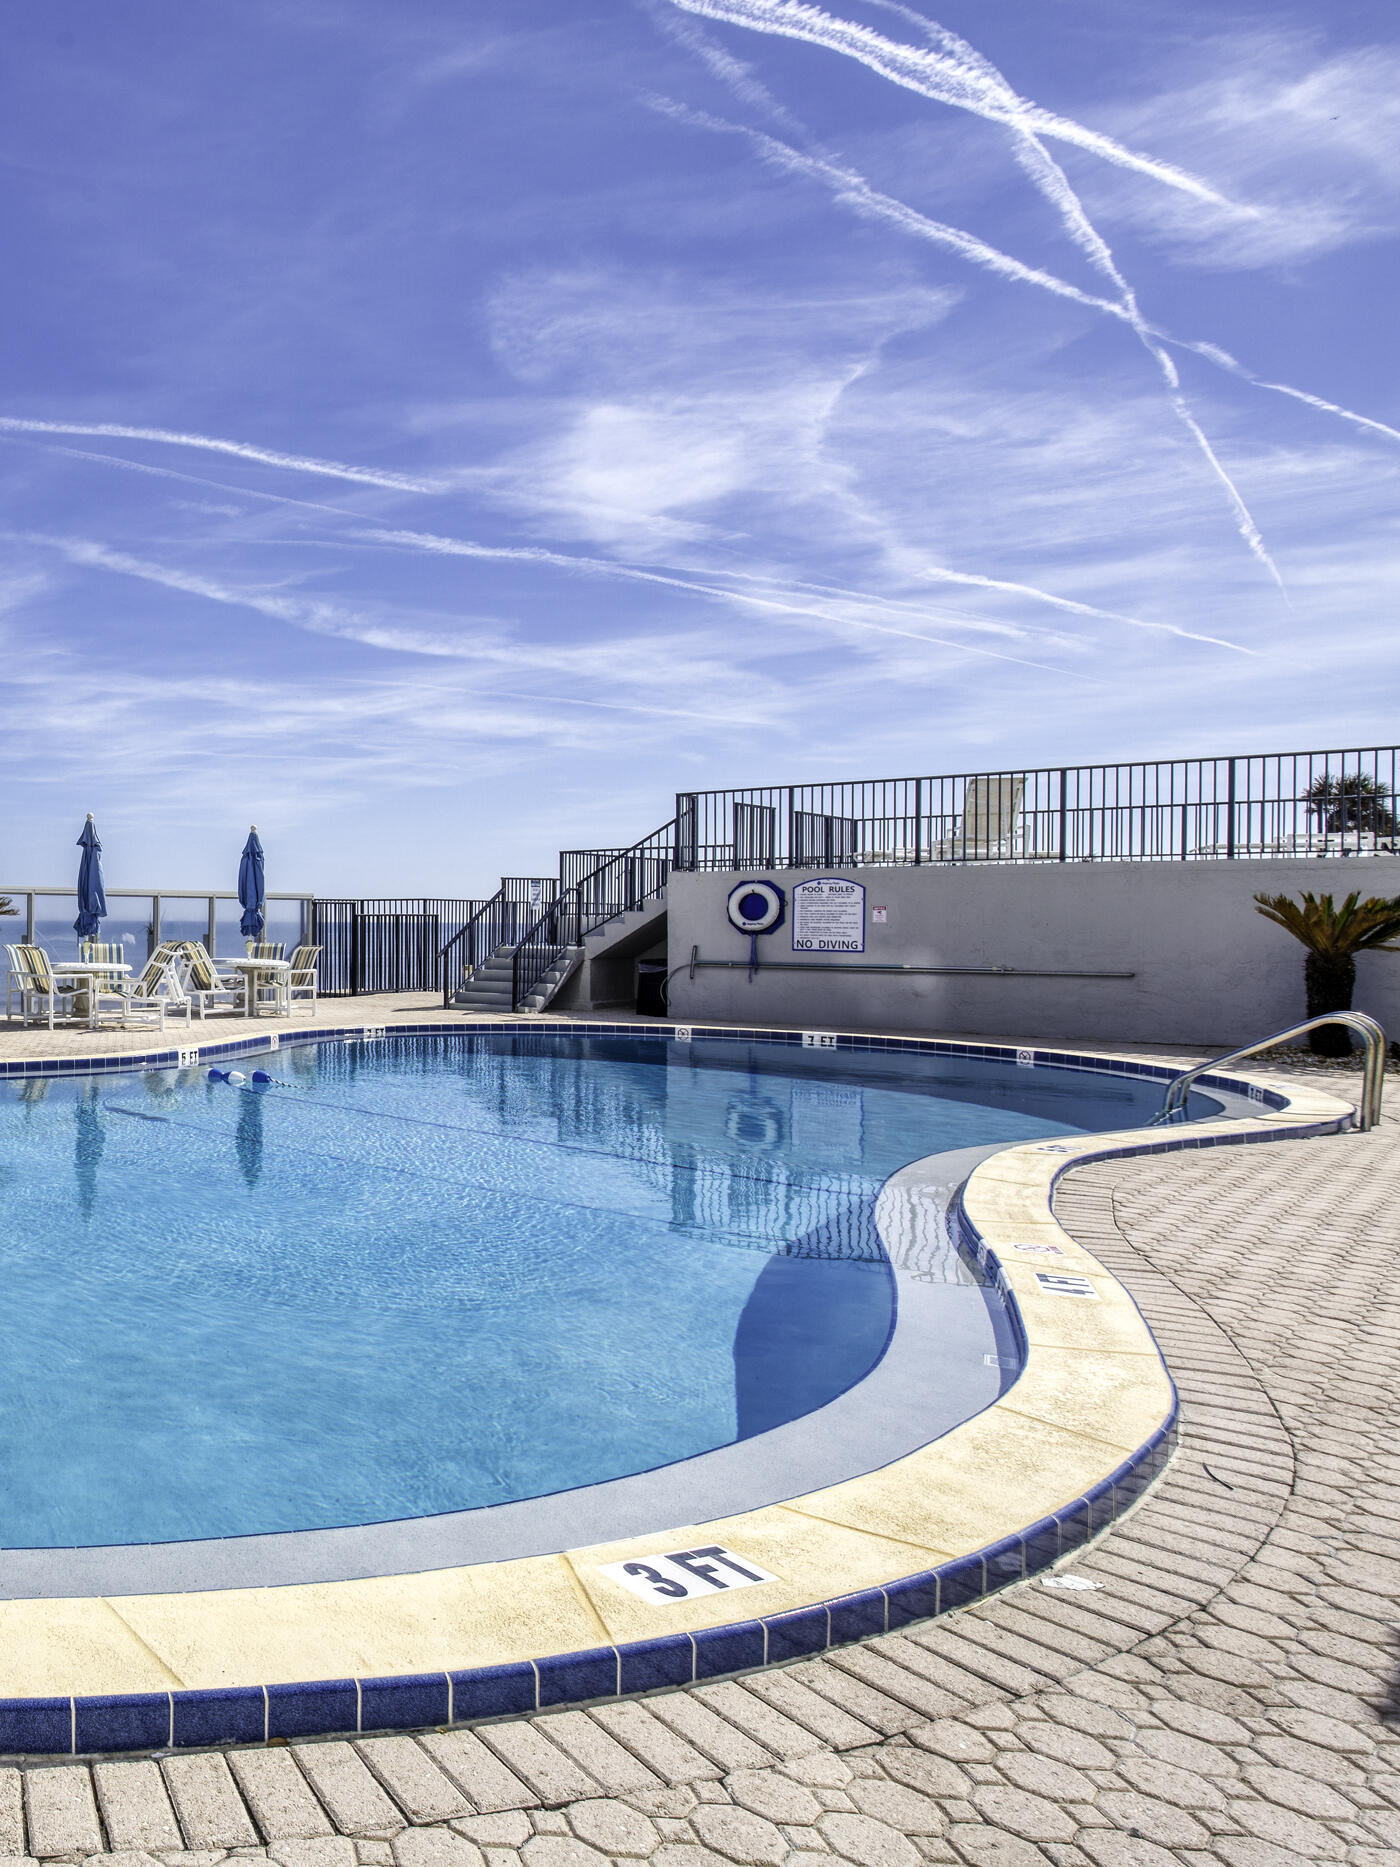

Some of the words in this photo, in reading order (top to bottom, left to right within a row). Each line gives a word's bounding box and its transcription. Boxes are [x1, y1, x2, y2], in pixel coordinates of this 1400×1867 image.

[796, 939, 813, 949] NO
[818, 939, 859, 950] DIVING
[622, 1562, 688, 1598] 3
[664, 1545, 765, 1589] FT
